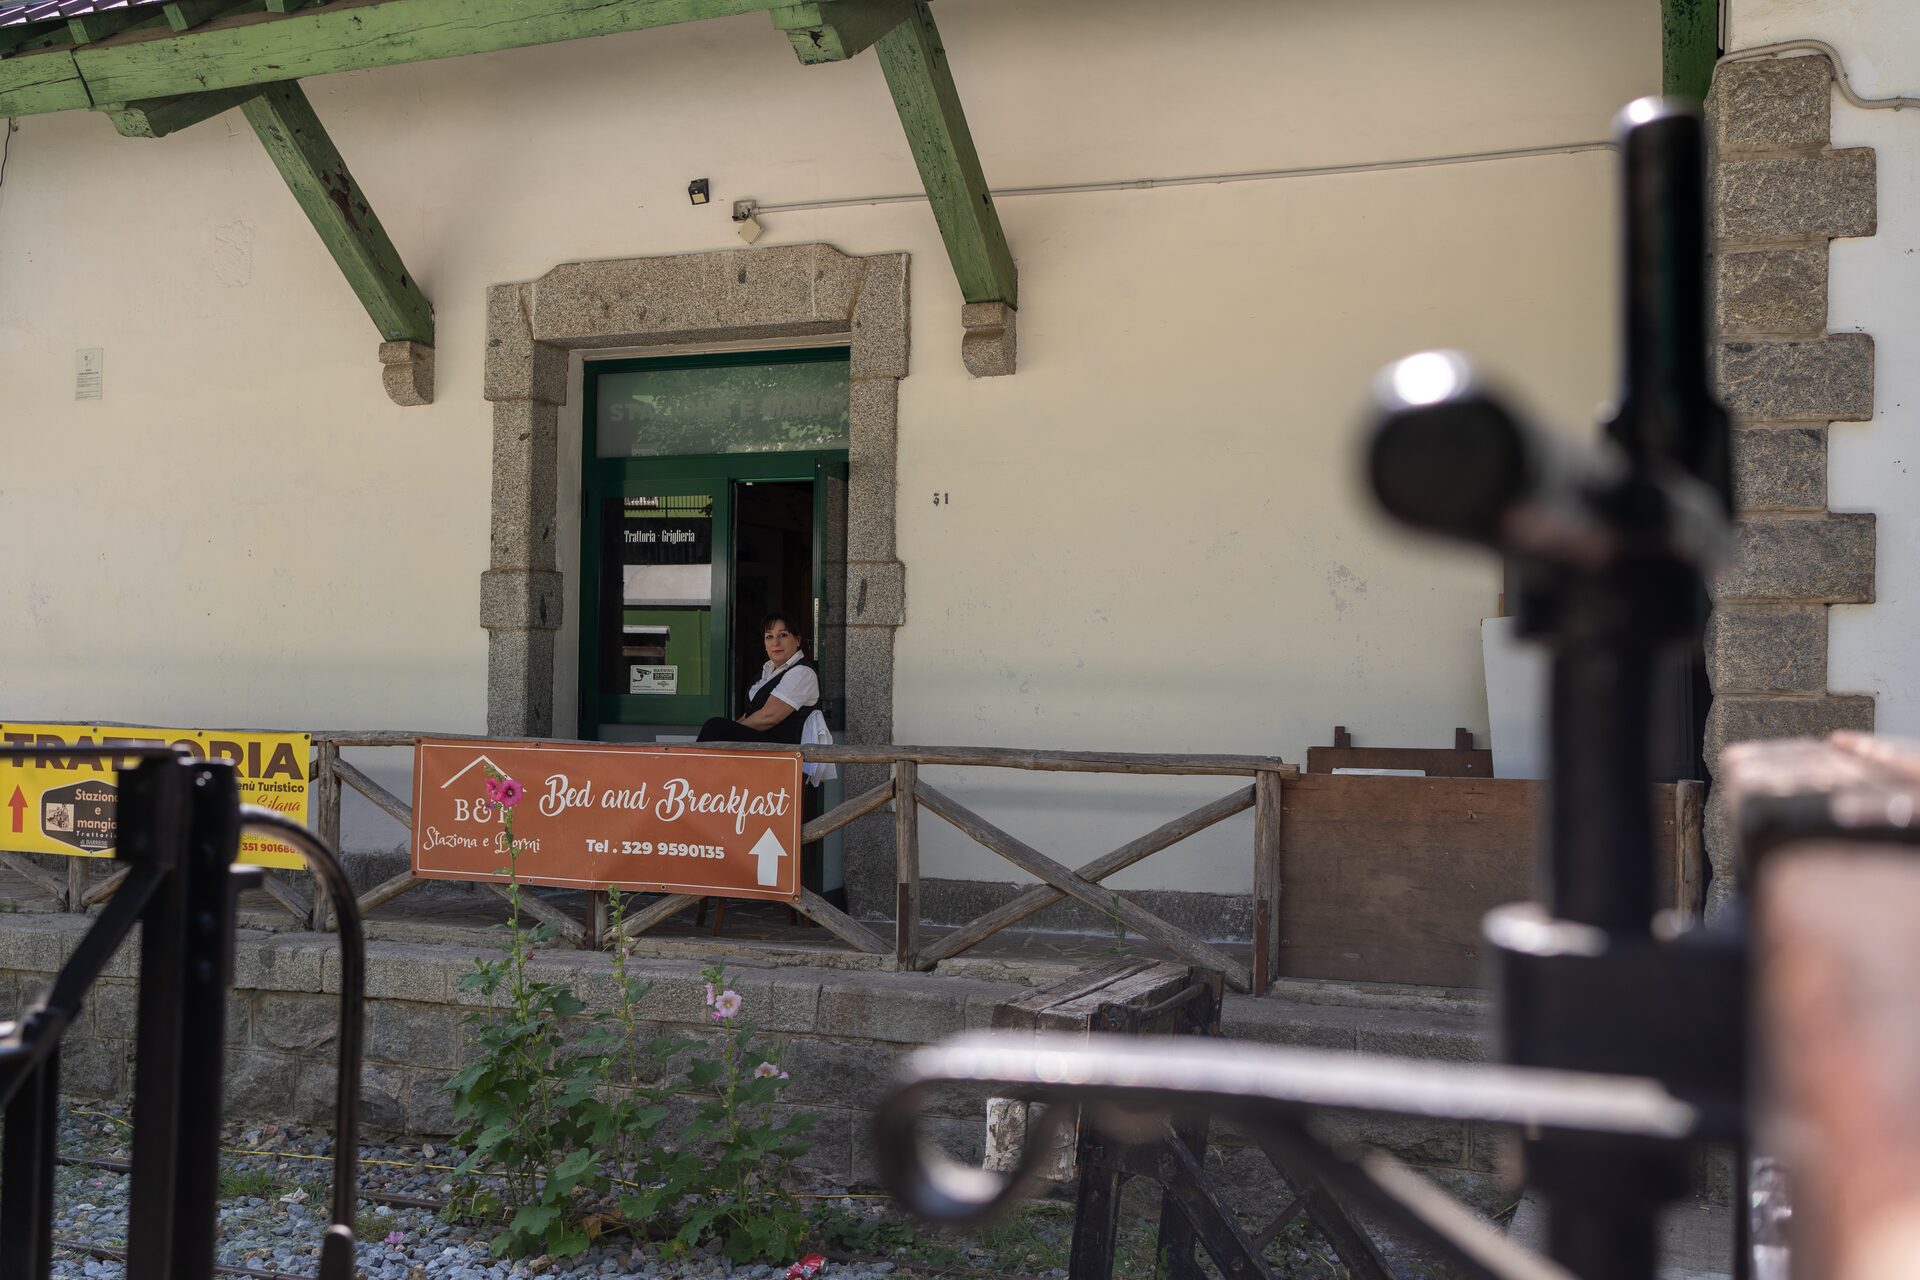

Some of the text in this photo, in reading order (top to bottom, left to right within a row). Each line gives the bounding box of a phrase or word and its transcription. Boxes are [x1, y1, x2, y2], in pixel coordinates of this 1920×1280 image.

[623, 529, 656, 543] Trattoria
[661, 529, 695, 545] Griglieria
[257, 781, 304, 793] Turistico
[94, 806, 102, 816] e
[538, 773, 791, 835] Bed and Breakfast
[423, 826, 477, 851] Staziona
[482, 836, 489, 847] e
[242, 842, 300, 854] 351 901686
[621, 840, 653, 855] 329
[657, 842, 725, 860] 9590135
